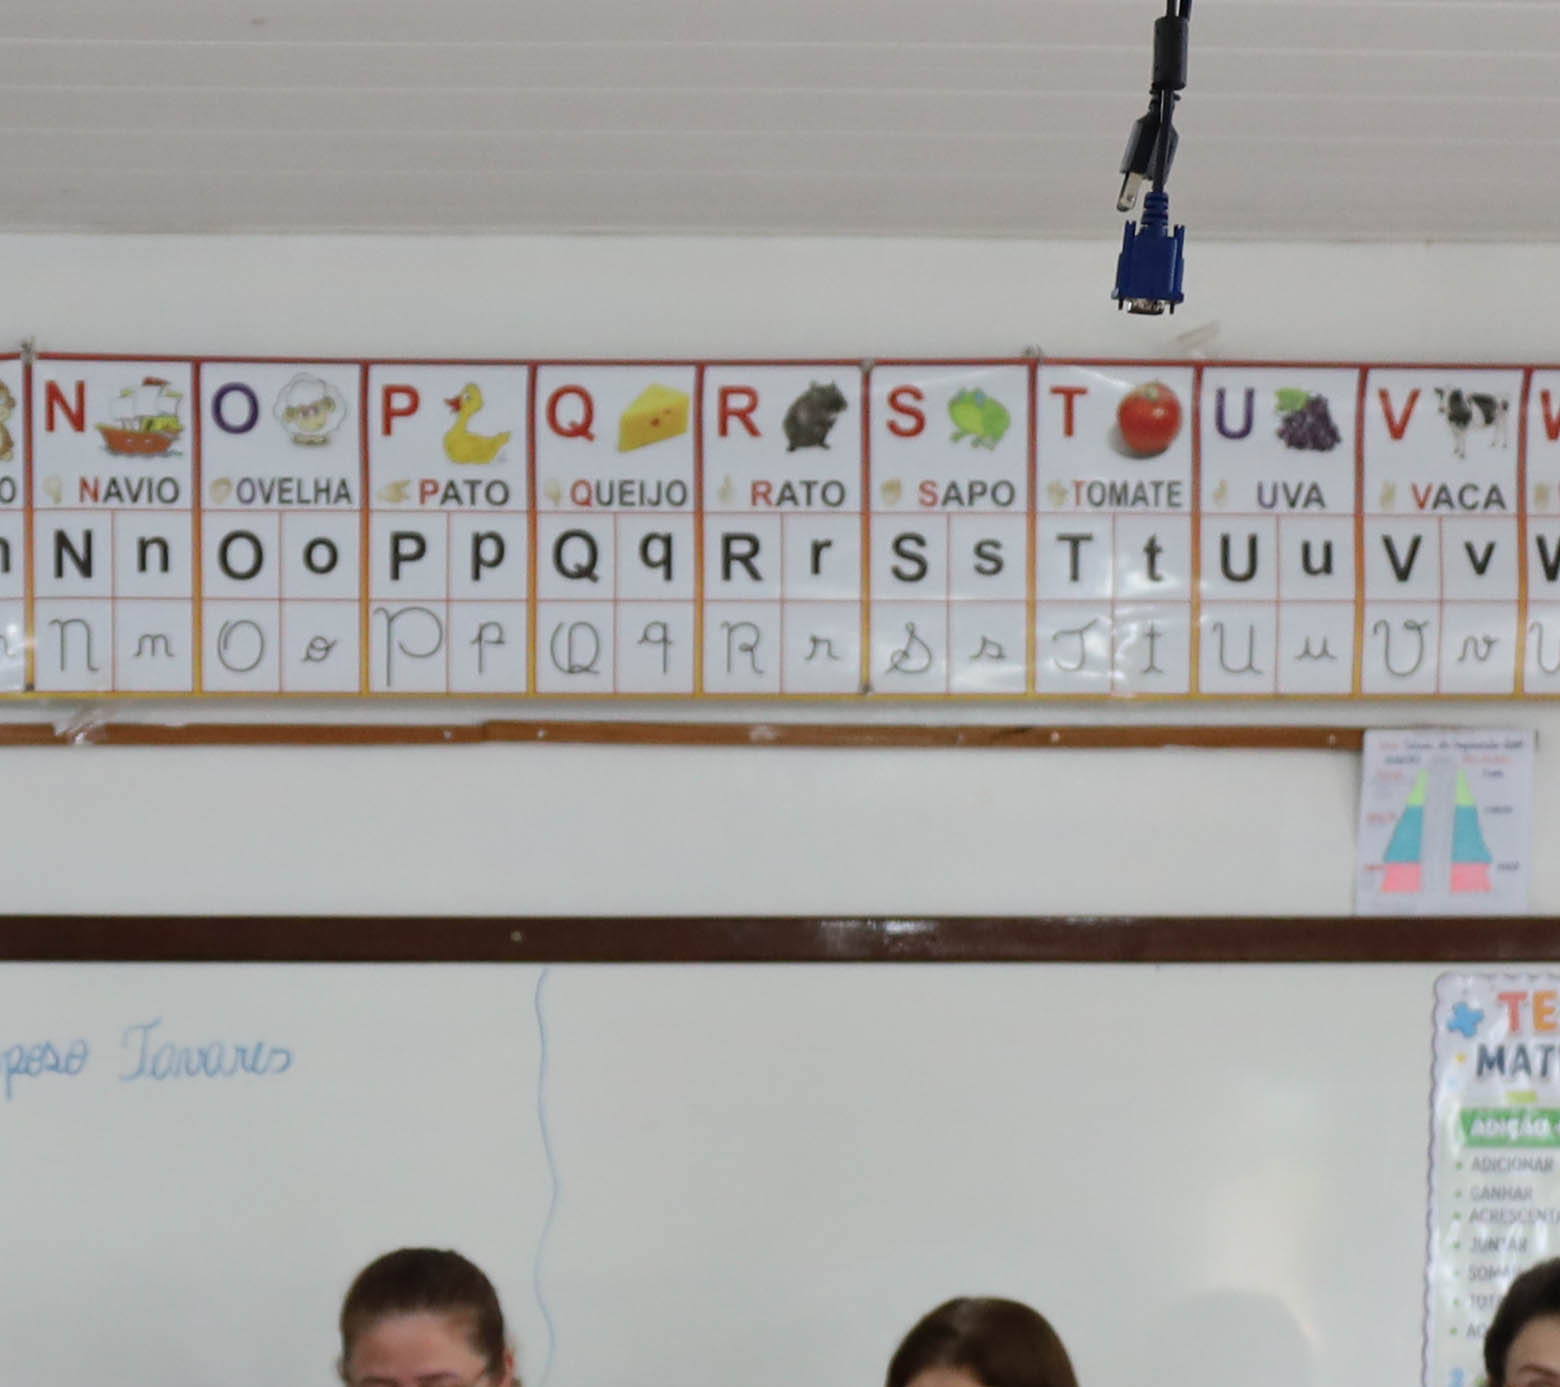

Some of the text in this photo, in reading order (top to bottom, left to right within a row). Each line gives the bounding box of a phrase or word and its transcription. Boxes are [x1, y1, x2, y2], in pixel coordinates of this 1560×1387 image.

[80, 476, 179, 504] NAVIO
[236, 476, 352, 505] OVELHA
[419, 478, 511, 507] PATO
[570, 478, 687, 508] QUEIJO
[751, 479, 846, 508] RATO
[918, 479, 1015, 508] SAPO
[1073, 479, 1182, 508] TOMATE
[1257, 481, 1326, 509] UVA
[1411, 482, 1506, 510] VACA
[118, 1016, 294, 1082] Tavares
